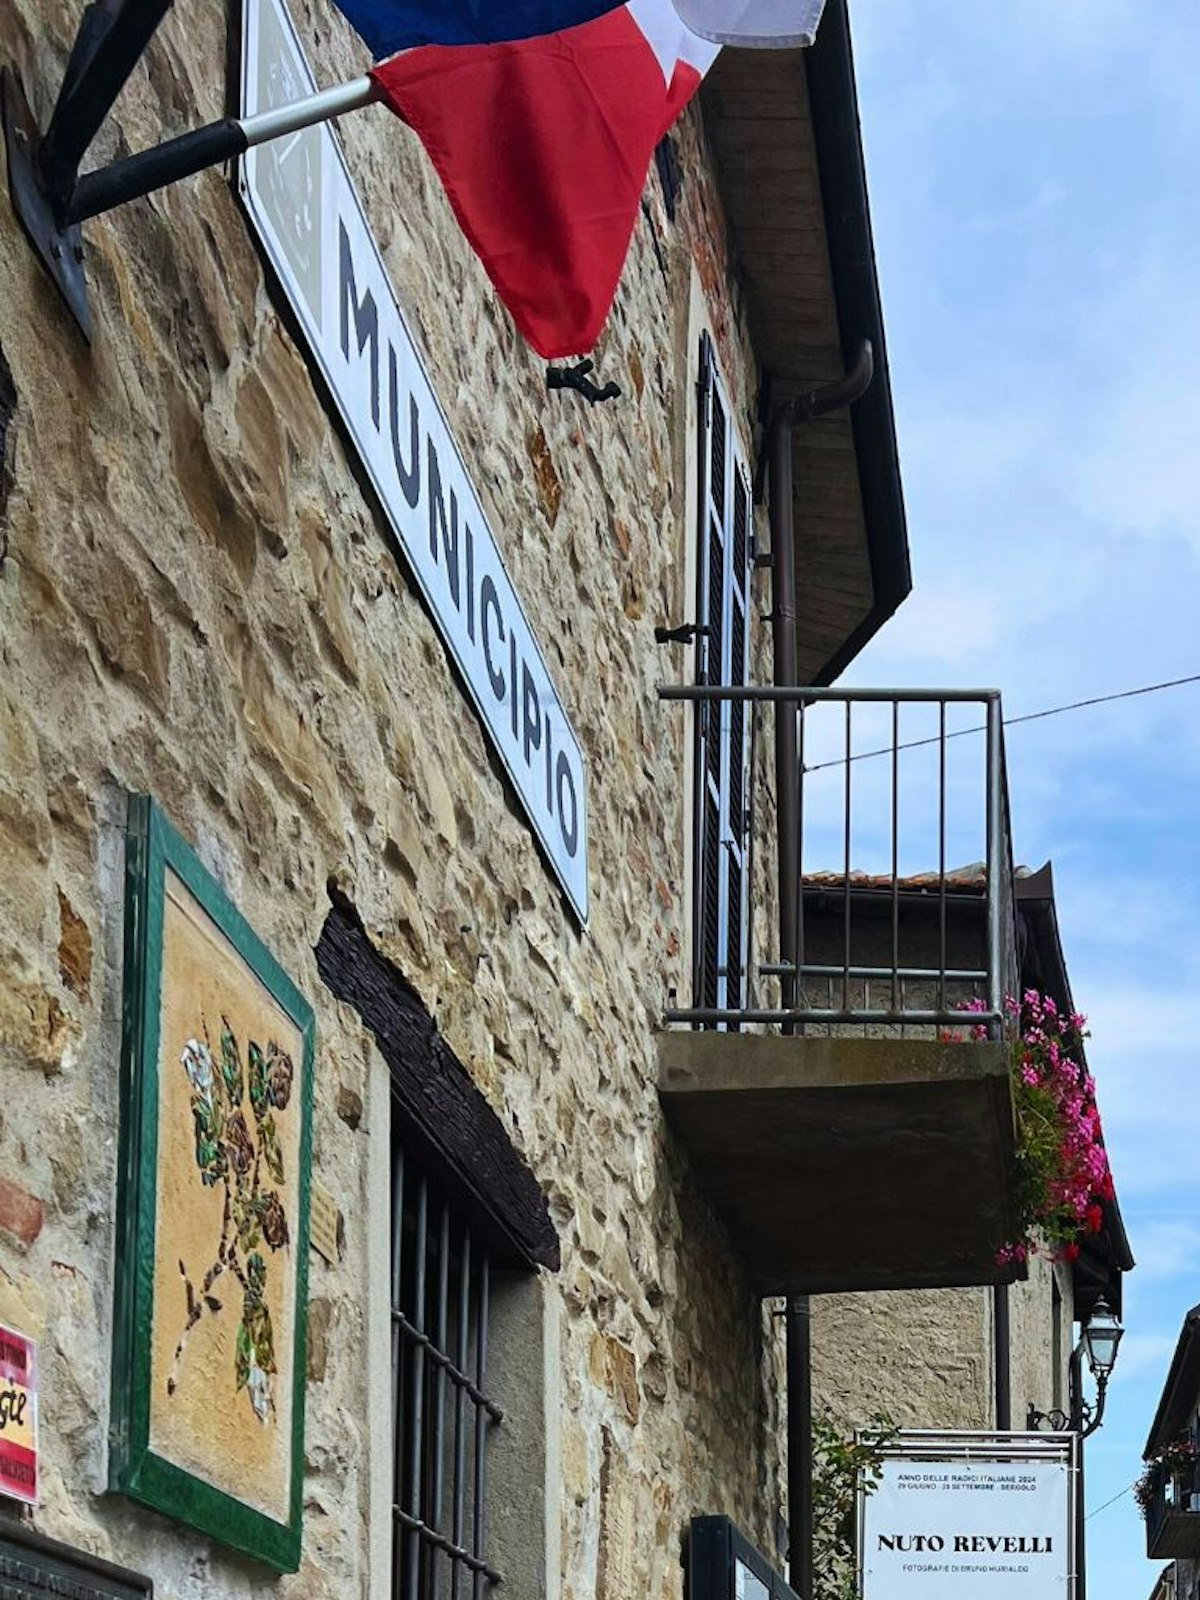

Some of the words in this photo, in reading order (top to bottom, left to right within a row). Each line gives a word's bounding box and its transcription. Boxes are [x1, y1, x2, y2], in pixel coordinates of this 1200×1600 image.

[339, 213, 580, 859] MUNICIPIO
[923, 1474, 949, 1482] DELLE
[877, 1534, 944, 1552] NUTO
[953, 1535, 1053, 1553] REVELLI
[902, 1563, 950, 1573] FOTOGRAFIE
